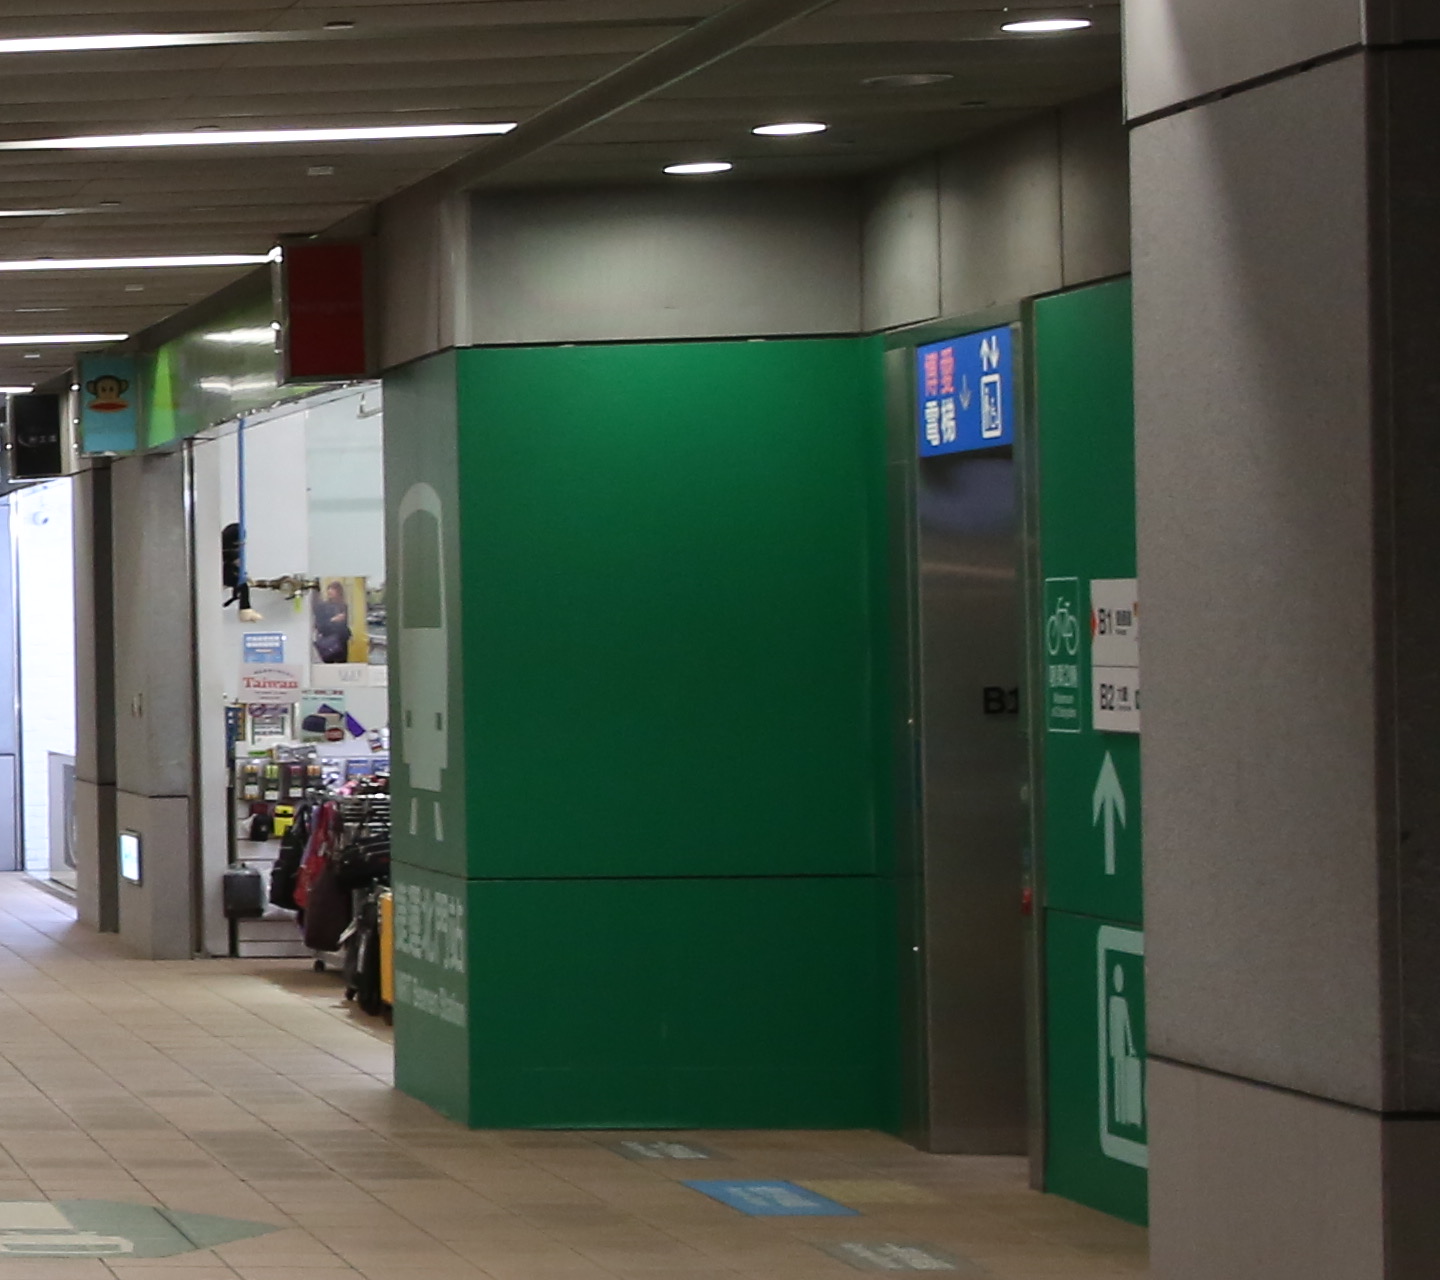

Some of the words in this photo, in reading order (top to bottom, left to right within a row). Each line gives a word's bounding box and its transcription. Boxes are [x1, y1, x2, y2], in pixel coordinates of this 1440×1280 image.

[1097, 608, 1113, 635] B1
[242, 676, 298, 689] Taiwan
[983, 686, 1019, 715] B1
[1100, 683, 1115, 710] B2
